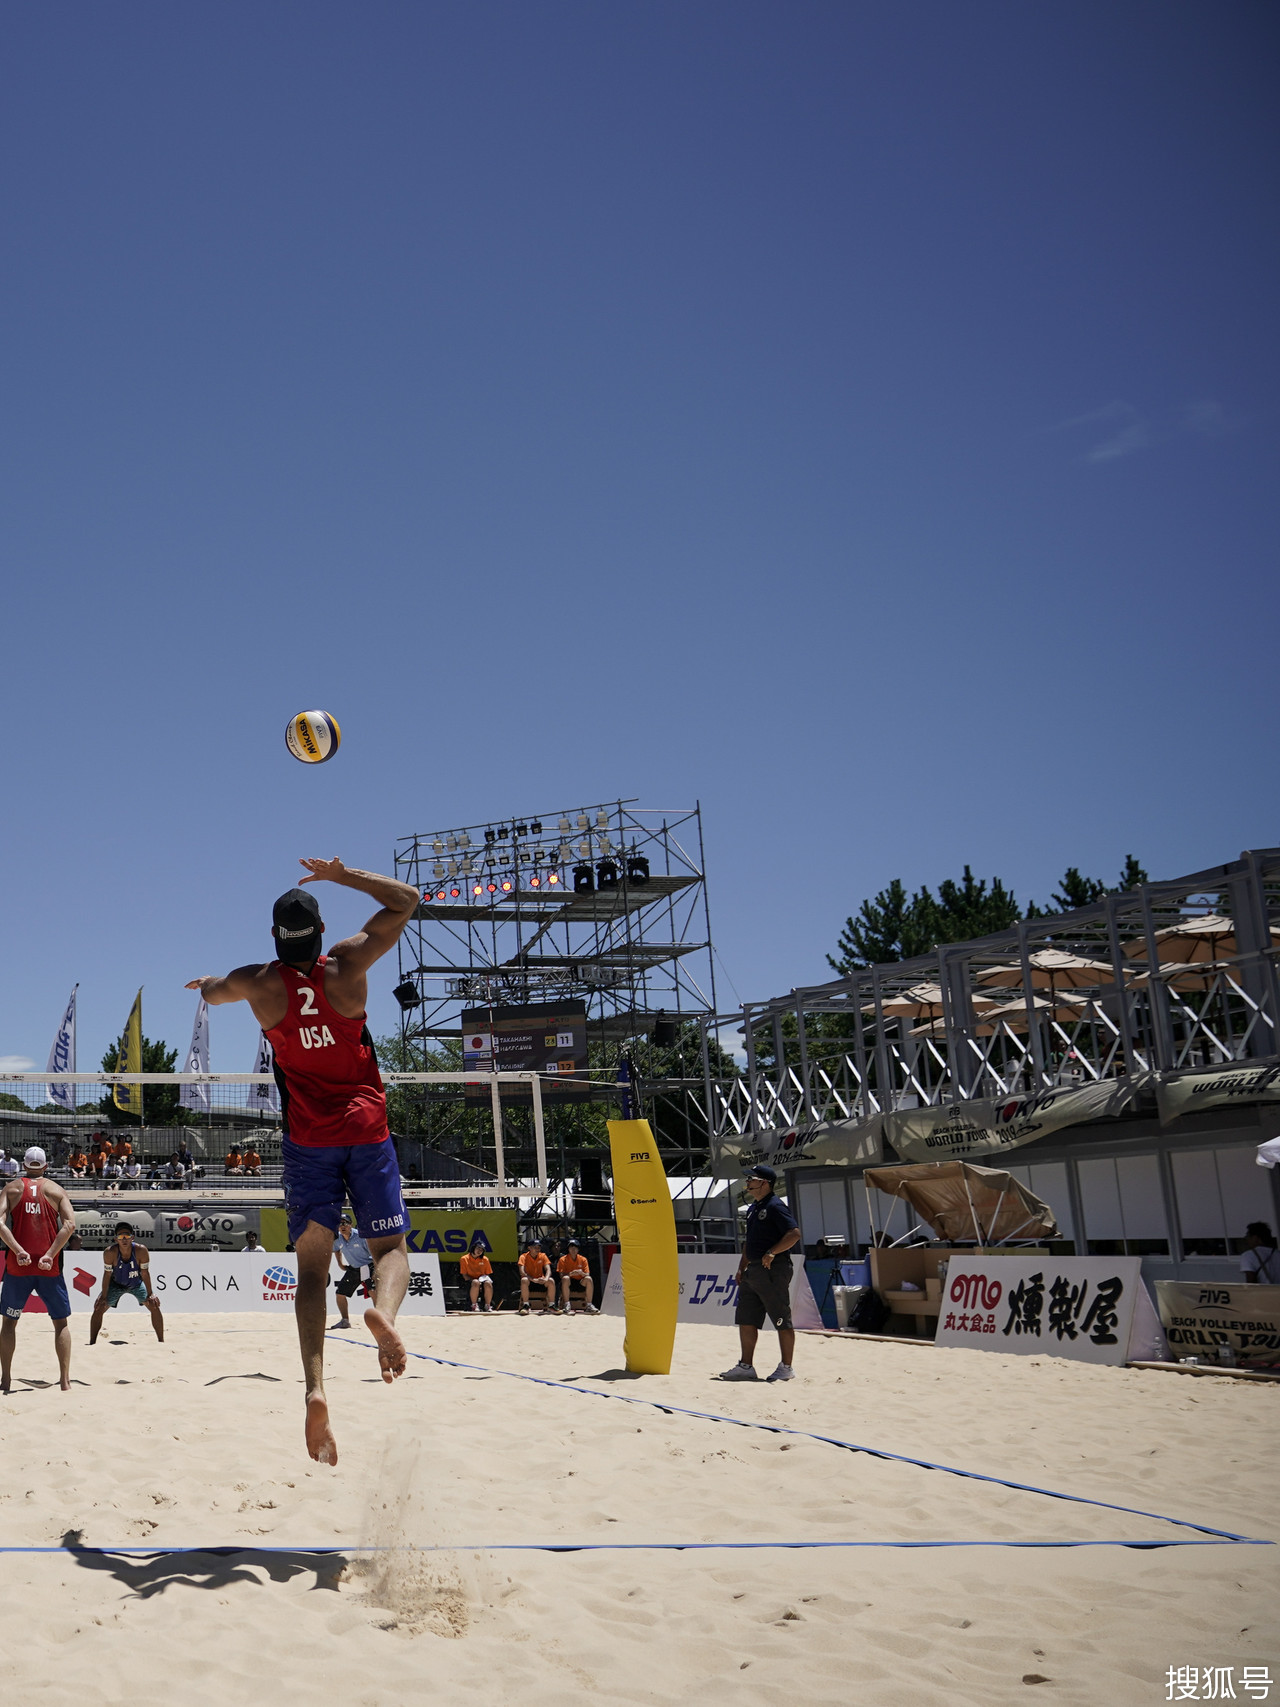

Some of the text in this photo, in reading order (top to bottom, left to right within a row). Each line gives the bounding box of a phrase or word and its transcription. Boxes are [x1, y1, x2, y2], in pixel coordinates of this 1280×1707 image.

[299, 718, 318, 754] MIKASA
[297, 987, 318, 1015] 2
[298, 1025, 336, 1050] USA
[560, 1036, 569, 1044] 11
[1192, 1077, 1260, 1094] WORLD
[994, 1095, 1056, 1124] TOKYO
[925, 1128, 990, 1147] WORLD TOUR
[996, 1124, 1016, 1145] 2019
[630, 1152, 650, 1160] FIVB
[29, 1185, 37, 1197] 1
[25, 1202, 41, 1214] USA
[165, 1216, 233, 1231] TOKYO
[371, 1214, 404, 1232] CRABB
[75, 1229, 115, 1237] ORLD
[166, 1234, 195, 1244] 2019
[405, 1229, 493, 1253] KASA
[129, 1260, 135, 1269] 1
[128, 1271, 139, 1279] JPN
[156, 1274, 240, 1291] SONA
[1198, 1290, 1231, 1304] FIVB
[1002, 1272, 1123, 1345] 燻製屋
[943, 1312, 996, 1334] 丸大食品
[1200, 1319, 1277, 1332] VOLLEYBALL
[1167, 1328, 1280, 1349] ORLD TOU
